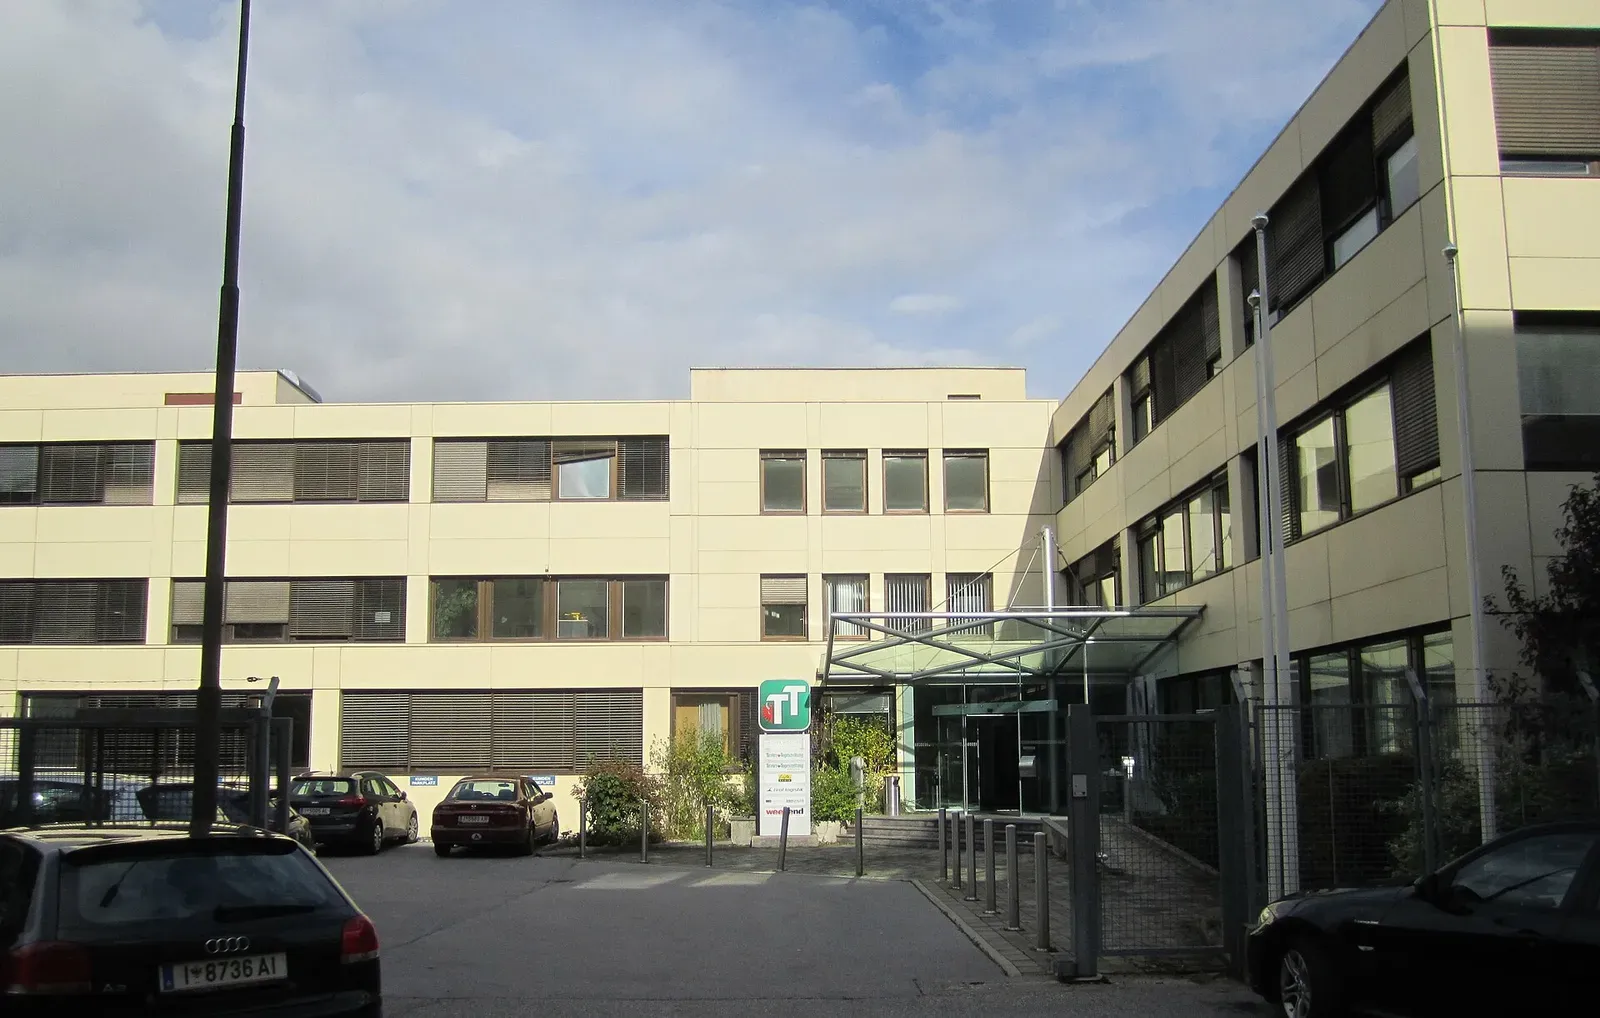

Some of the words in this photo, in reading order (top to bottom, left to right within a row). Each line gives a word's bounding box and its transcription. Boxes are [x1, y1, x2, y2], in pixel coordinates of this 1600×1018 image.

[766, 685, 806, 724] TT
[766, 807, 804, 815] weeend
[205, 958, 253, 982] 8736
[258, 956, 276, 976] AI
